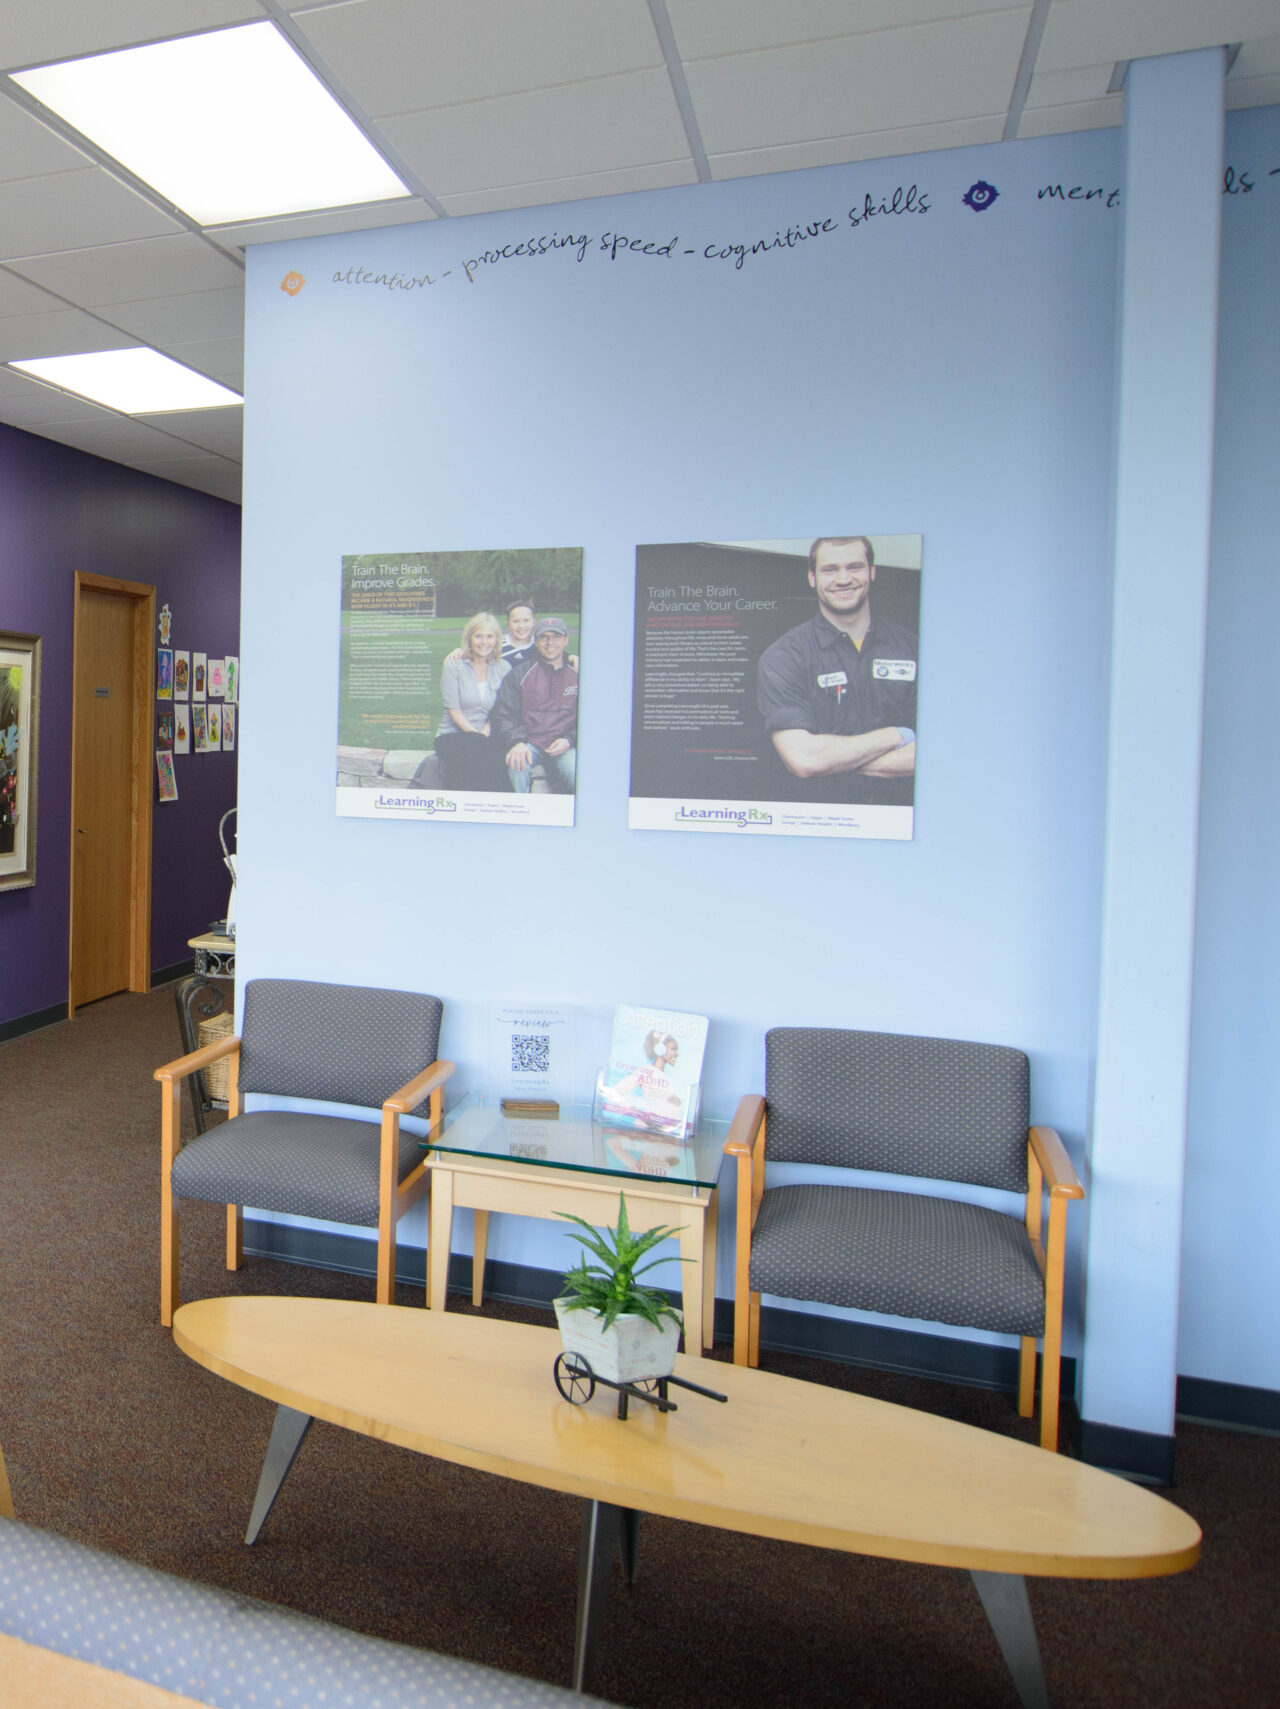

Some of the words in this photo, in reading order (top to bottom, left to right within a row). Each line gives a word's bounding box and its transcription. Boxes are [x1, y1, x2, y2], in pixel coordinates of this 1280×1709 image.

[332, 266, 435, 290] attention
[462, 232, 593, 283] processing
[600, 232, 679, 260] speed
[704, 218, 838, 270] cognitive
[848, 185, 932, 227] skills
[352, 565, 376, 576] Train
[378, 564, 399, 575] The
[401, 563, 430, 575] Brain.
[352, 578, 394, 590] Improve
[647, 586, 676, 598] Train
[679, 585, 703, 597] The
[706, 585, 740, 597] Brain.
[647, 600, 700, 612] Advance
[704, 599, 732, 611] Your
[735, 599, 779, 610] Career.
[379, 795, 453, 814] LearningRx
[681, 806, 769, 827] LearningRx
[637, 1074, 669, 1088] ADHD
